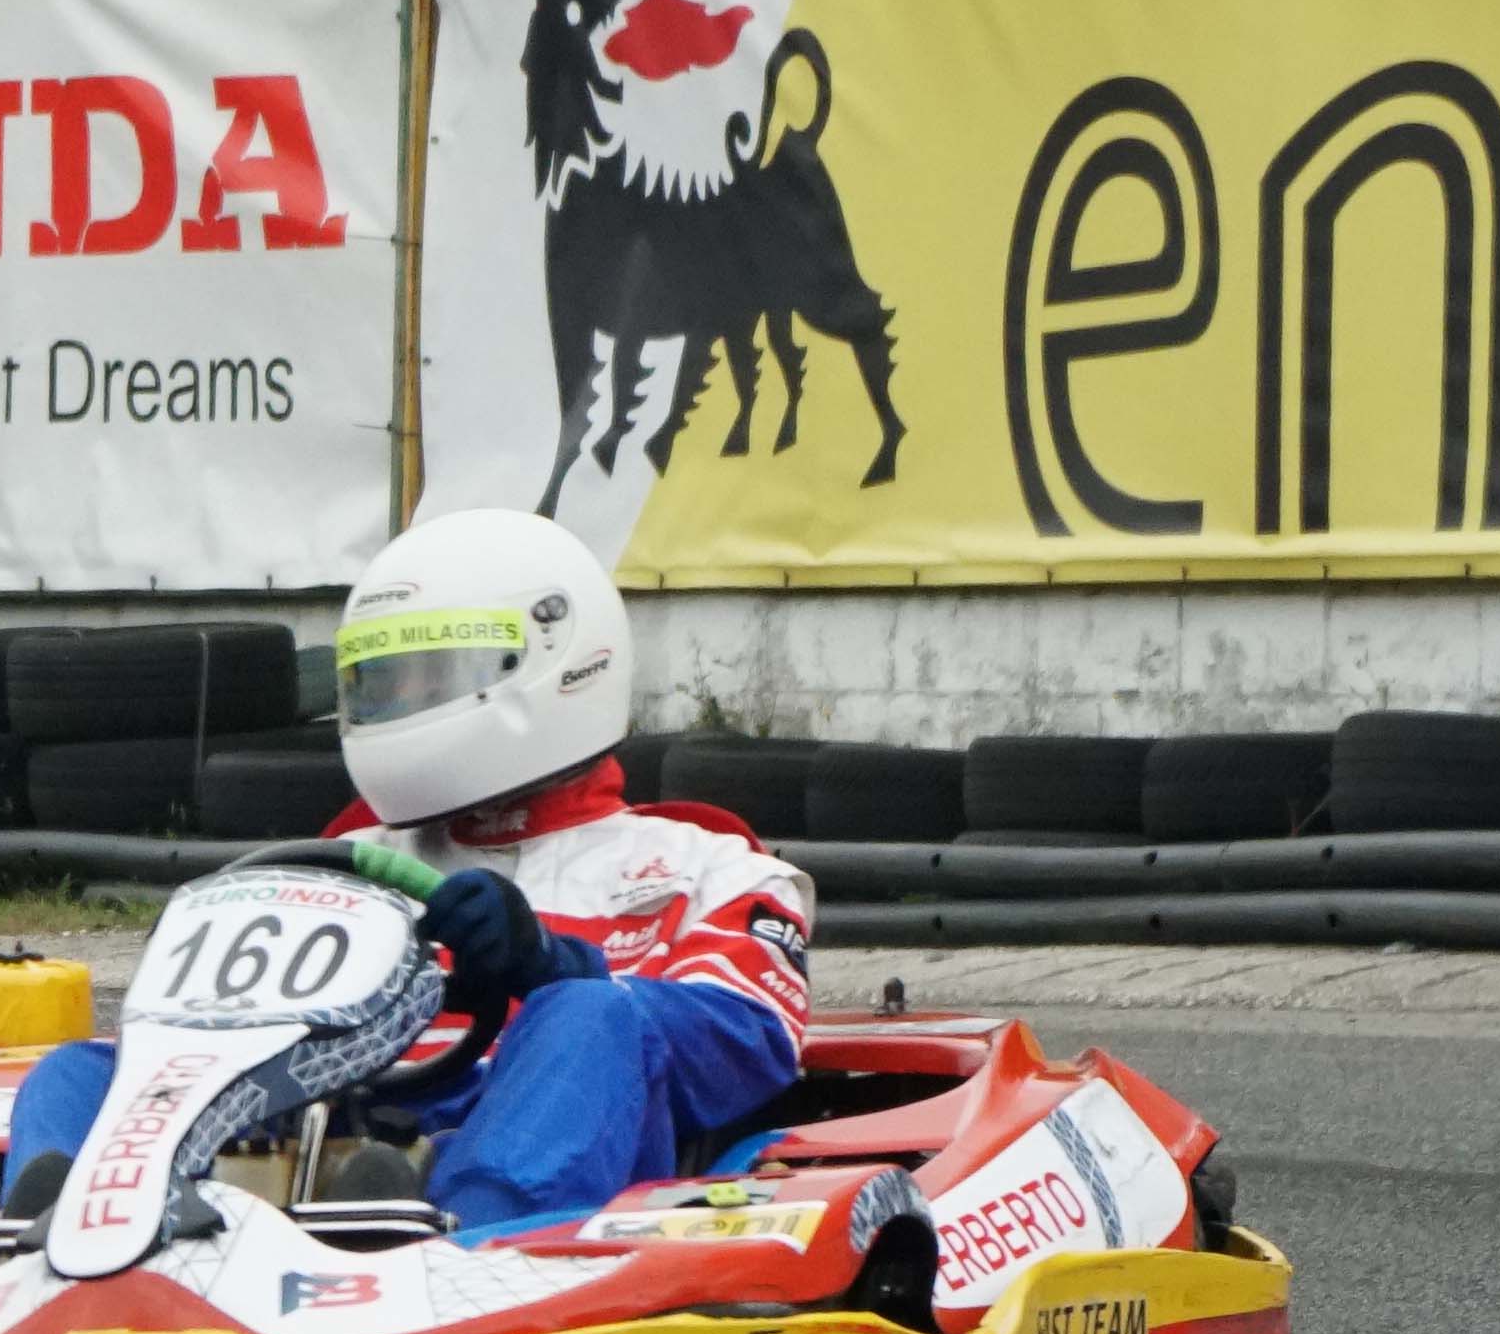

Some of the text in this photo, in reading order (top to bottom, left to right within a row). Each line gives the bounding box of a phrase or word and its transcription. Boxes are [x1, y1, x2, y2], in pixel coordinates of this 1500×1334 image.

[49, 339, 294, 424] Dreams
[400, 622, 519, 644] MILAGRES
[187, 886, 363, 909] EUROINDY
[163, 914, 350, 999] 160
[80, 1053, 219, 1231] FERBERTO
[934, 1171, 1086, 1292] ERBERTO
